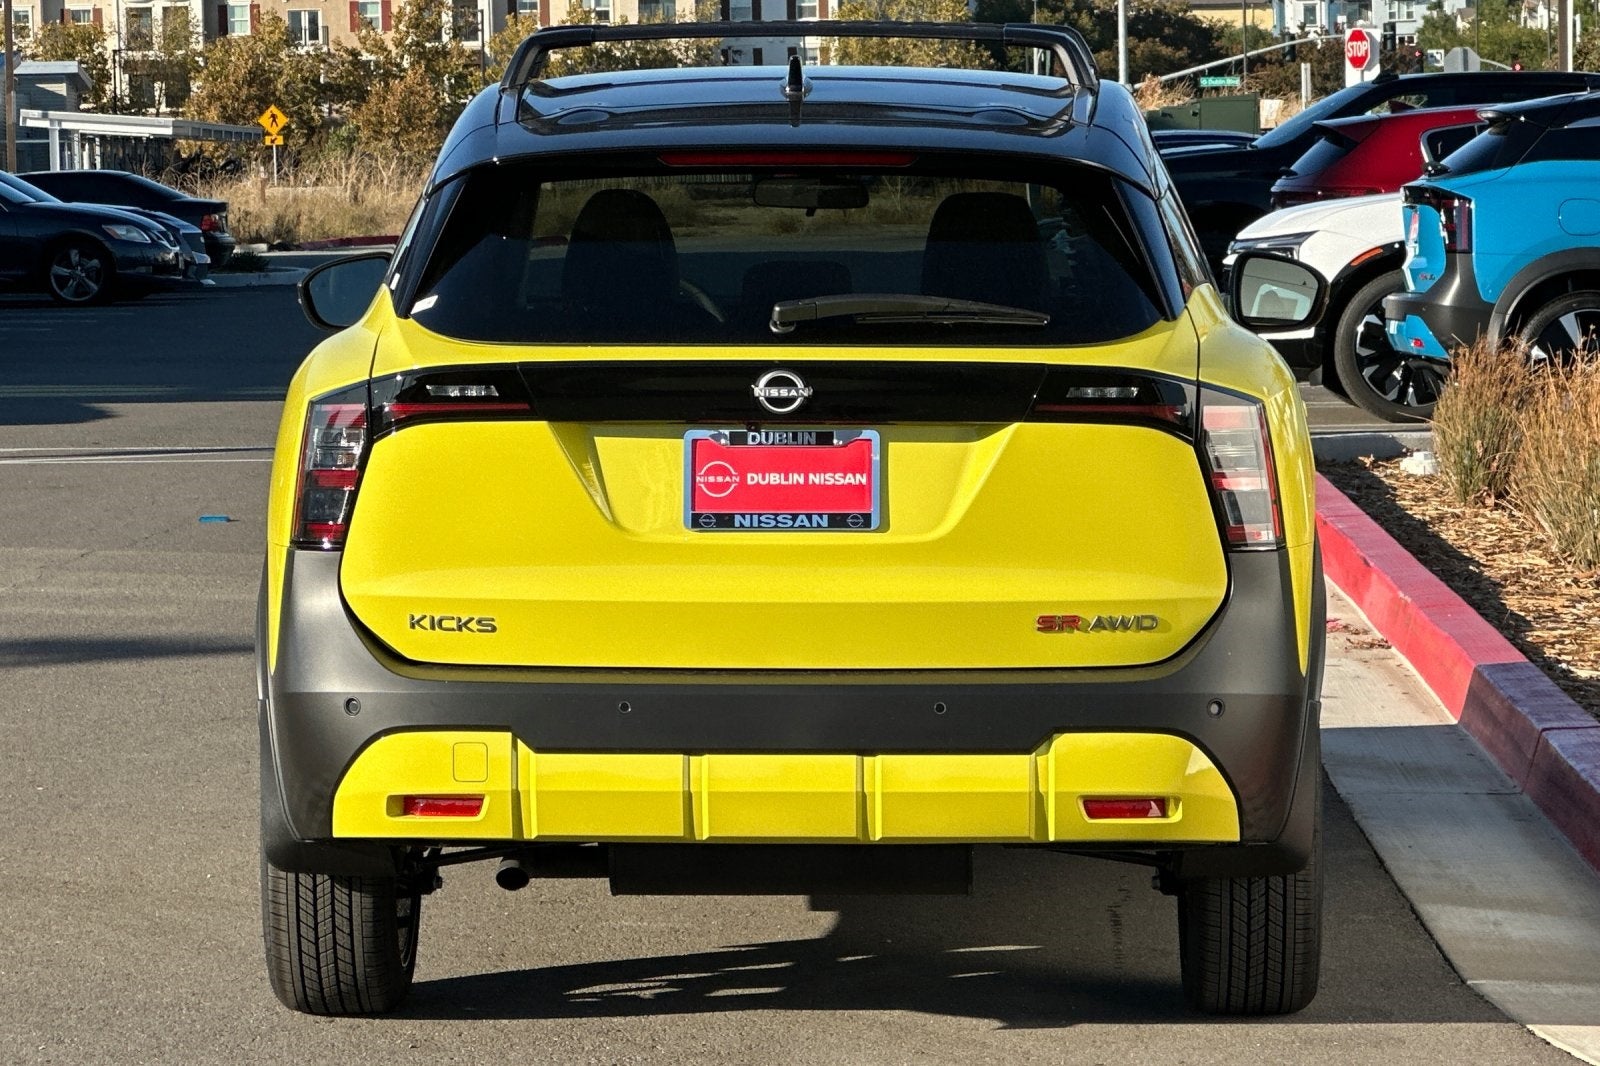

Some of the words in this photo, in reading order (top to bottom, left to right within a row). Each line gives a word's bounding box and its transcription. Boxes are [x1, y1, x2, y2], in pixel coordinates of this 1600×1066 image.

[1347, 41, 1368, 58] STOP
[754, 388, 808, 397] NISSAN
[747, 431, 816, 445] DUBLIN
[696, 475, 740, 483] NISSAN
[746, 473, 804, 485] DUBLIN
[808, 473, 867, 486] NISSAN
[734, 514, 829, 528] NISSAN
[409, 614, 497, 633] KICKS
[1037, 615, 1081, 631] SR
[1088, 615, 1158, 631] AWD
